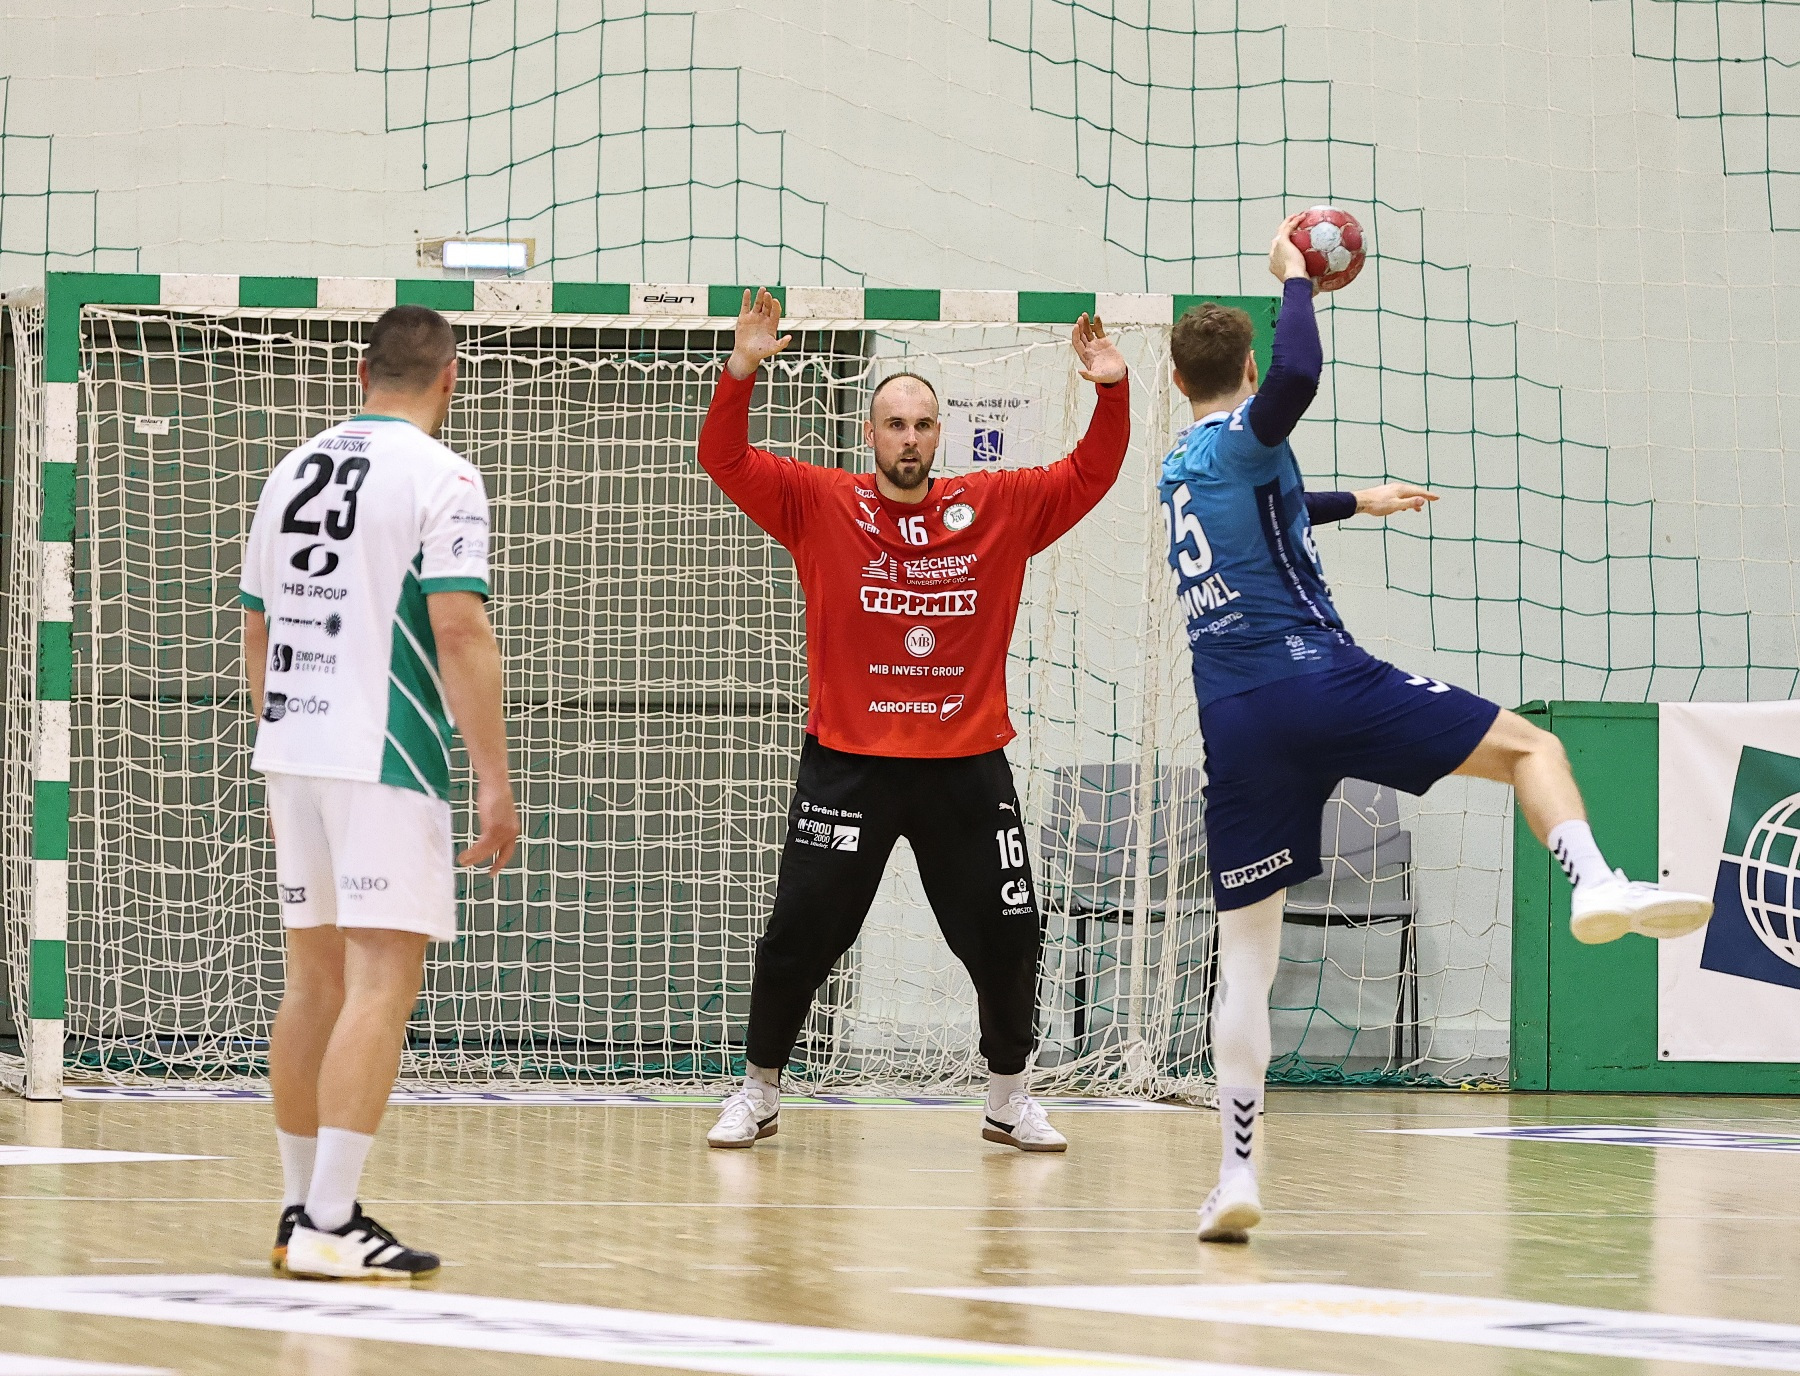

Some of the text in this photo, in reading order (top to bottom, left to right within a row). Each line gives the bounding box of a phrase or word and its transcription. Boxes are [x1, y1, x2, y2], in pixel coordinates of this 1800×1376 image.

[643, 293, 695, 304] elan
[280, 452, 371, 541] 23
[897, 515, 929, 546] 16
[903, 553, 978, 571] SZÉCHENYI
[906, 565, 969, 579] EGYETEM
[281, 582, 305, 596] HB
[314, 652, 337, 665] PLUS
[869, 664, 965, 676] MIB INVEST GROUP
[286, 695, 330, 716] GYŐR
[868, 700, 937, 713] AGROFEED
[840, 809, 863, 819] Bank
[813, 833, 831, 844] 2000
[996, 826, 1025, 870] 16
